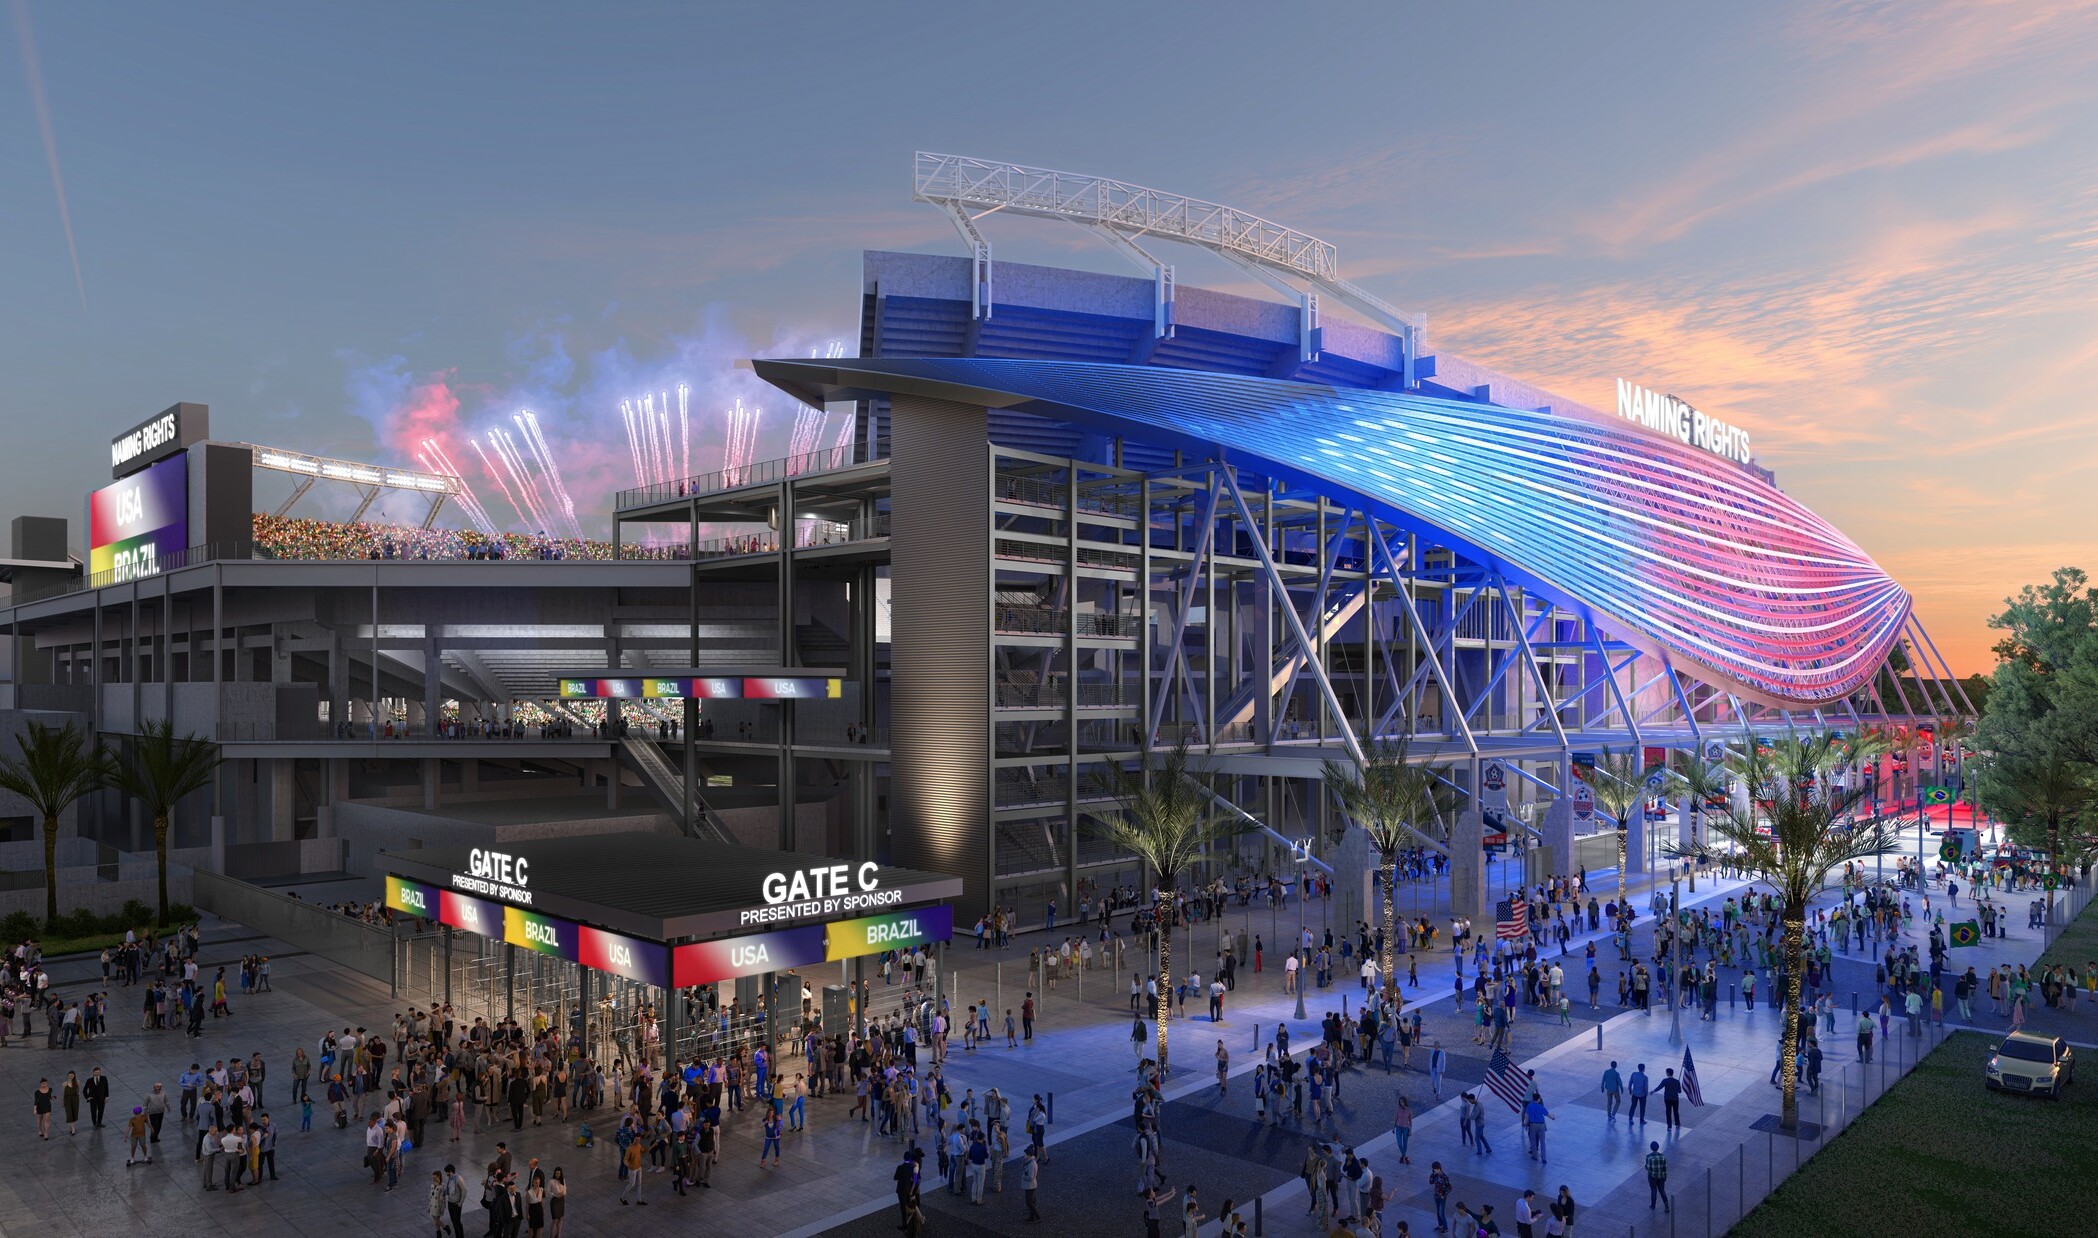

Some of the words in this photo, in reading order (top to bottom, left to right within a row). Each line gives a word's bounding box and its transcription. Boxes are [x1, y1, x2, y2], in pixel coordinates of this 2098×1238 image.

[112, 430, 142, 467] NAMING
[143, 413, 175, 452] RIGHTS
[1616, 377, 1690, 445] NAMING
[1693, 410, 1750, 465] RIGHTS
[116, 486, 143, 527] USA
[114, 542, 160, 584] BRAZIL
[567, 683, 586, 693] BRAZIL
[612, 683, 624, 693] USA
[657, 683, 680, 694] BRAZIL
[711, 683, 726, 693] USA
[774, 683, 796, 694] USA
[470, 848, 512, 884] GATE
[515, 857, 528, 886] C
[762, 864, 849, 904] GATE
[858, 861, 879, 892] C
[452, 874, 489, 894] PRESENTED
[489, 883, 499, 896] BY
[499, 885, 532, 905] SPONSOR
[740, 901, 821, 925] PRESENTED
[824, 898, 842, 913] BY
[843, 890, 902, 910] SPONSOR
[400, 887, 426, 909] BRAZIL
[461, 903, 478, 924] USA
[525, 920, 559, 947] BRAZIL
[608, 943, 632, 968] USA
[731, 944, 769, 967] USA
[867, 918, 922, 945] BRAZIL
